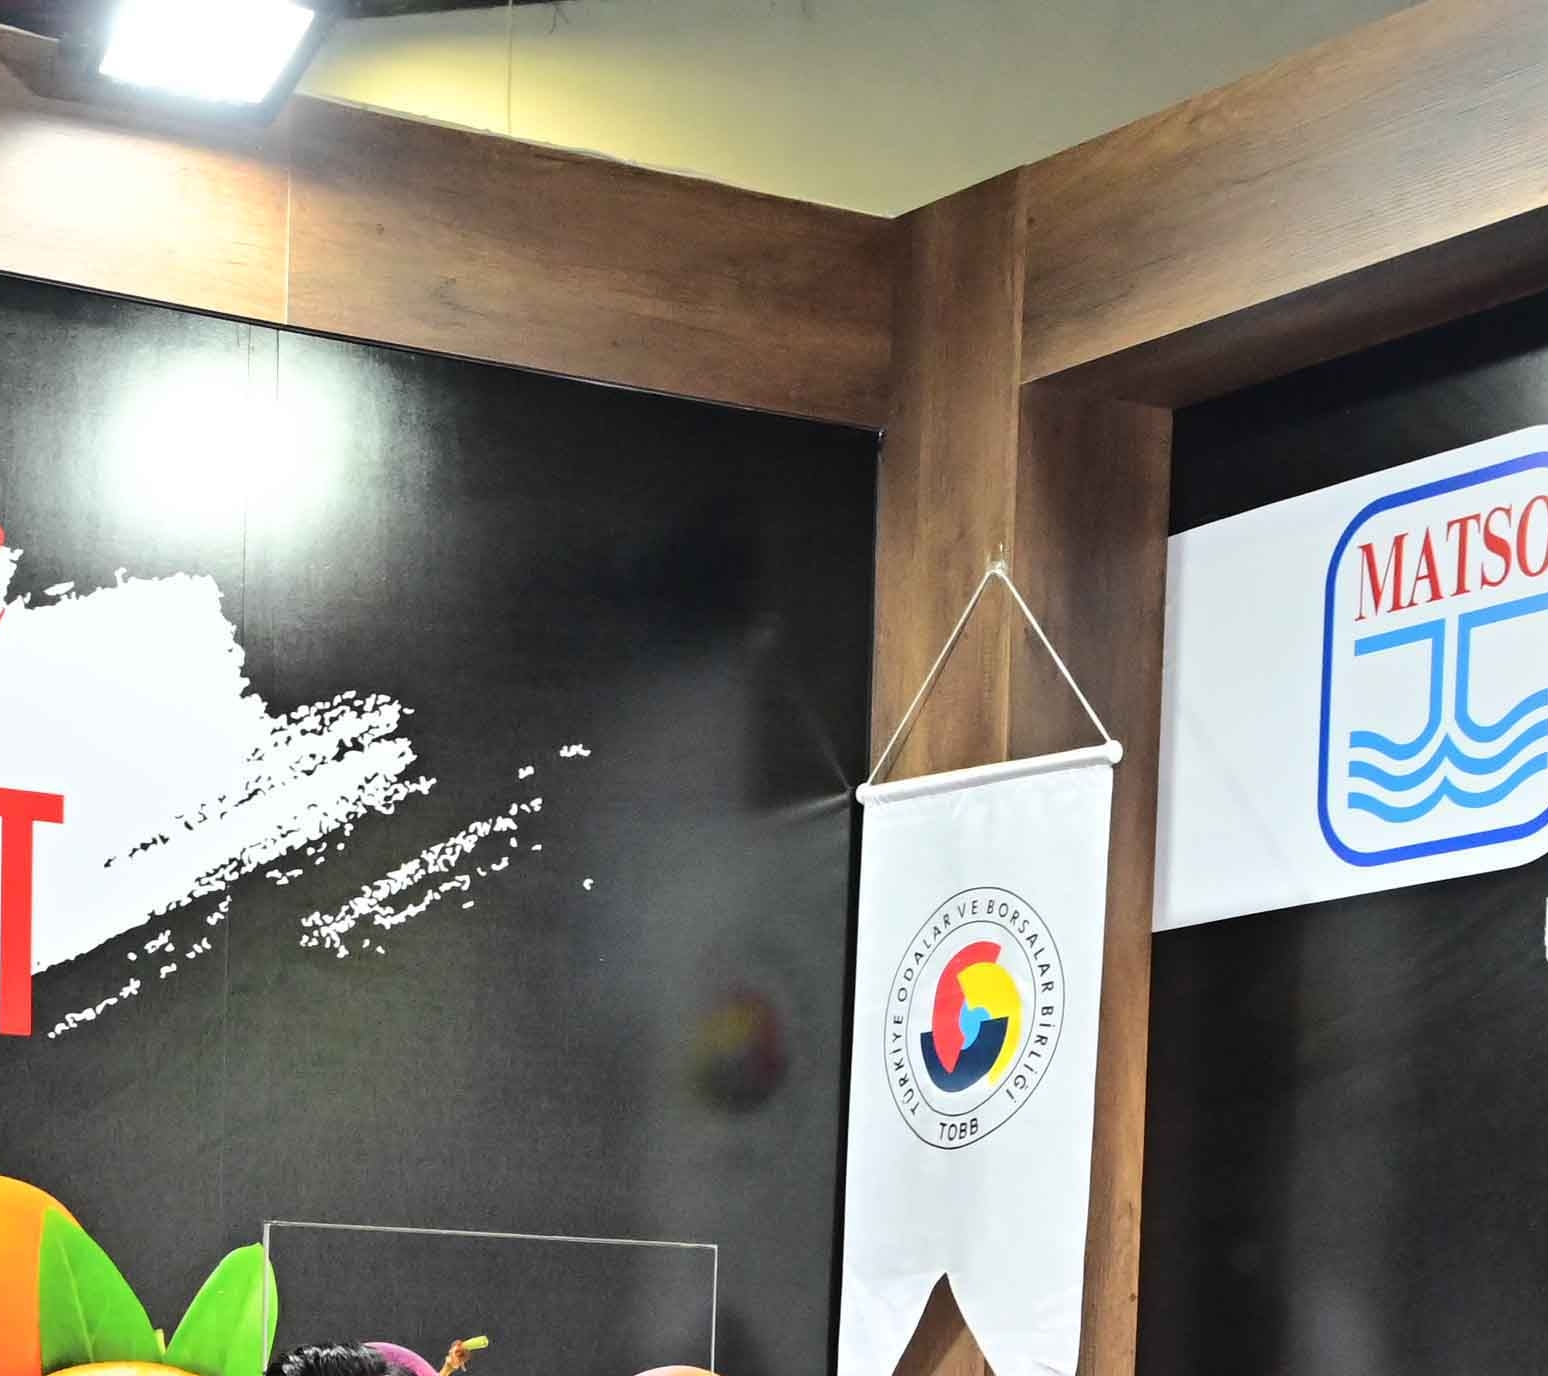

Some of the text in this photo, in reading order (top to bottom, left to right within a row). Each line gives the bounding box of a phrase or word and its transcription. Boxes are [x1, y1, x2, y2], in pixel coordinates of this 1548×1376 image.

[889, 899, 1056, 1116] TÜRKİYE ODALAR VE BORSALAR BİRLİĞİ
[938, 1117, 980, 1142] TOBB
